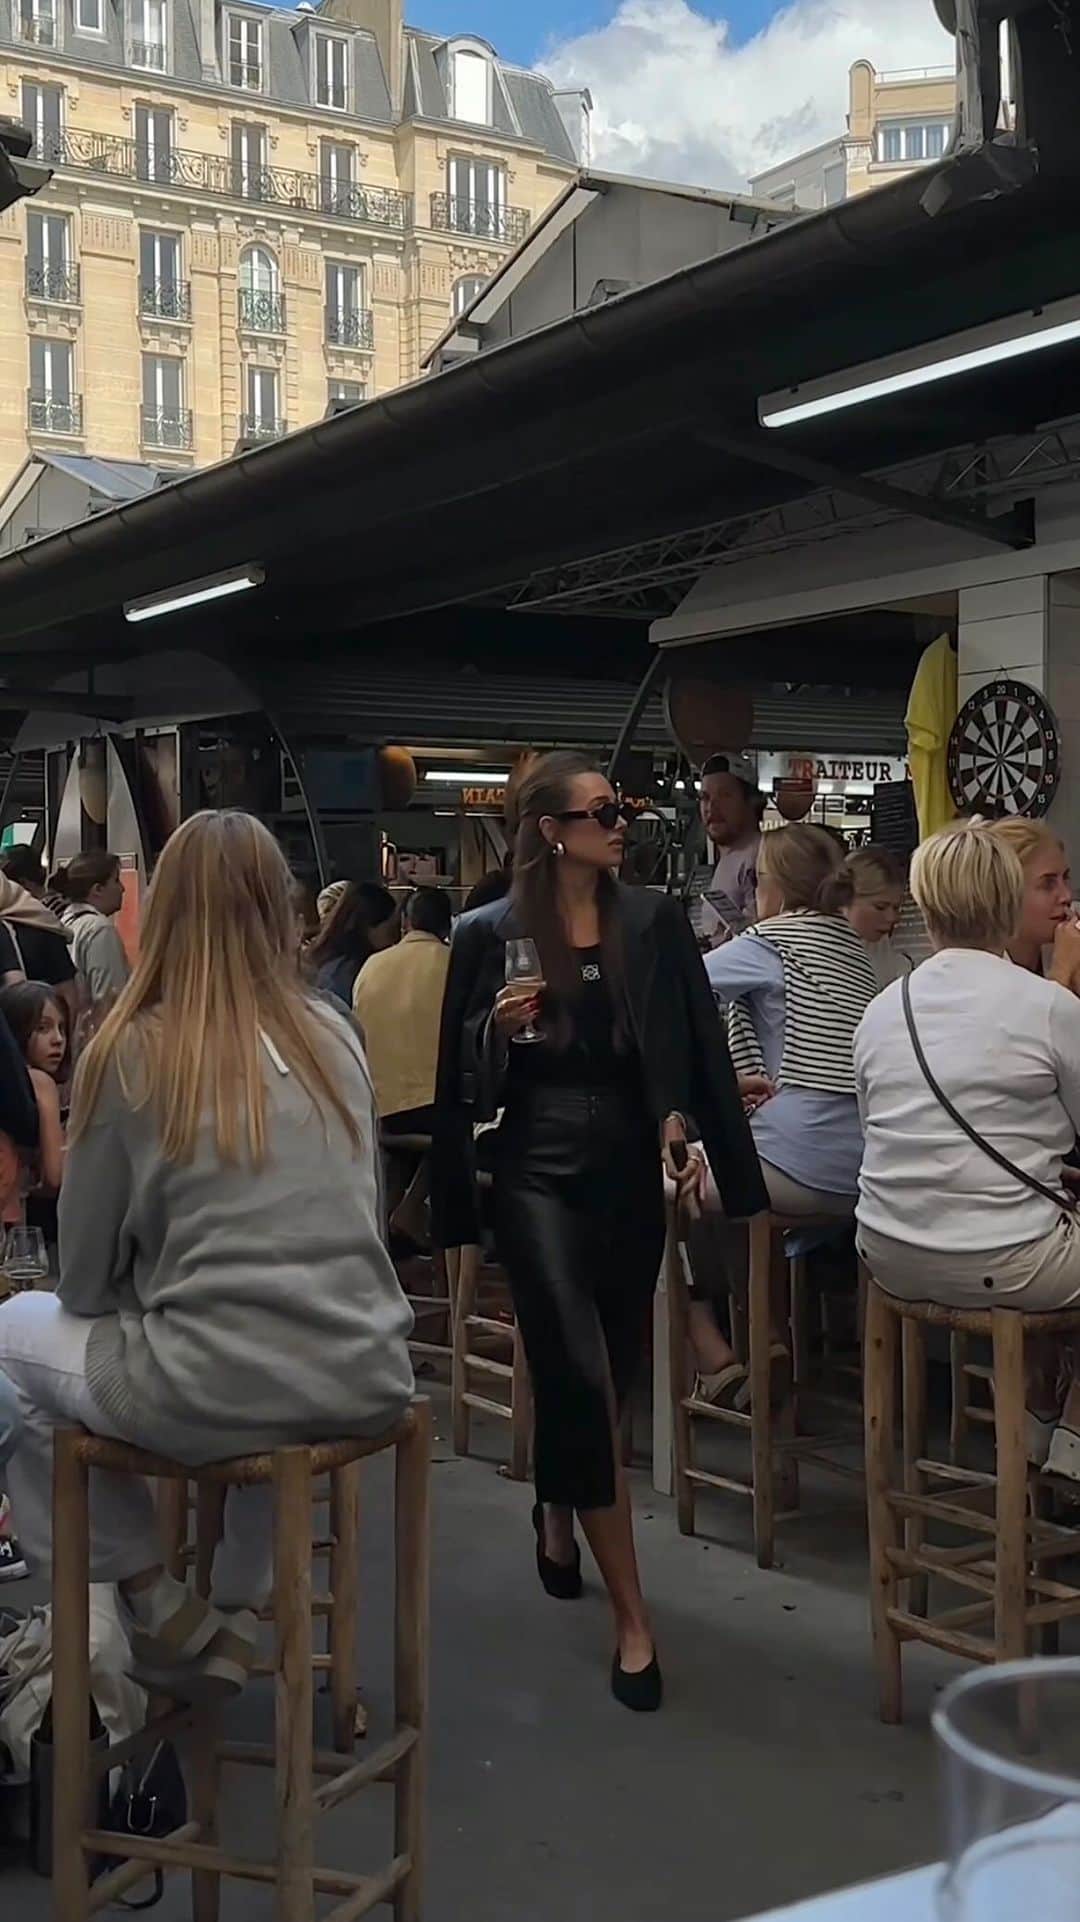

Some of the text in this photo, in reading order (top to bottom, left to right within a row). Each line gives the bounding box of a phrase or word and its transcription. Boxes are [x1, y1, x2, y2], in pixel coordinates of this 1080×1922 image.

[996, 685, 1007, 694] 20
[788, 759, 892, 781] TRAITEUR
[1045, 774, 1054, 784] 10
